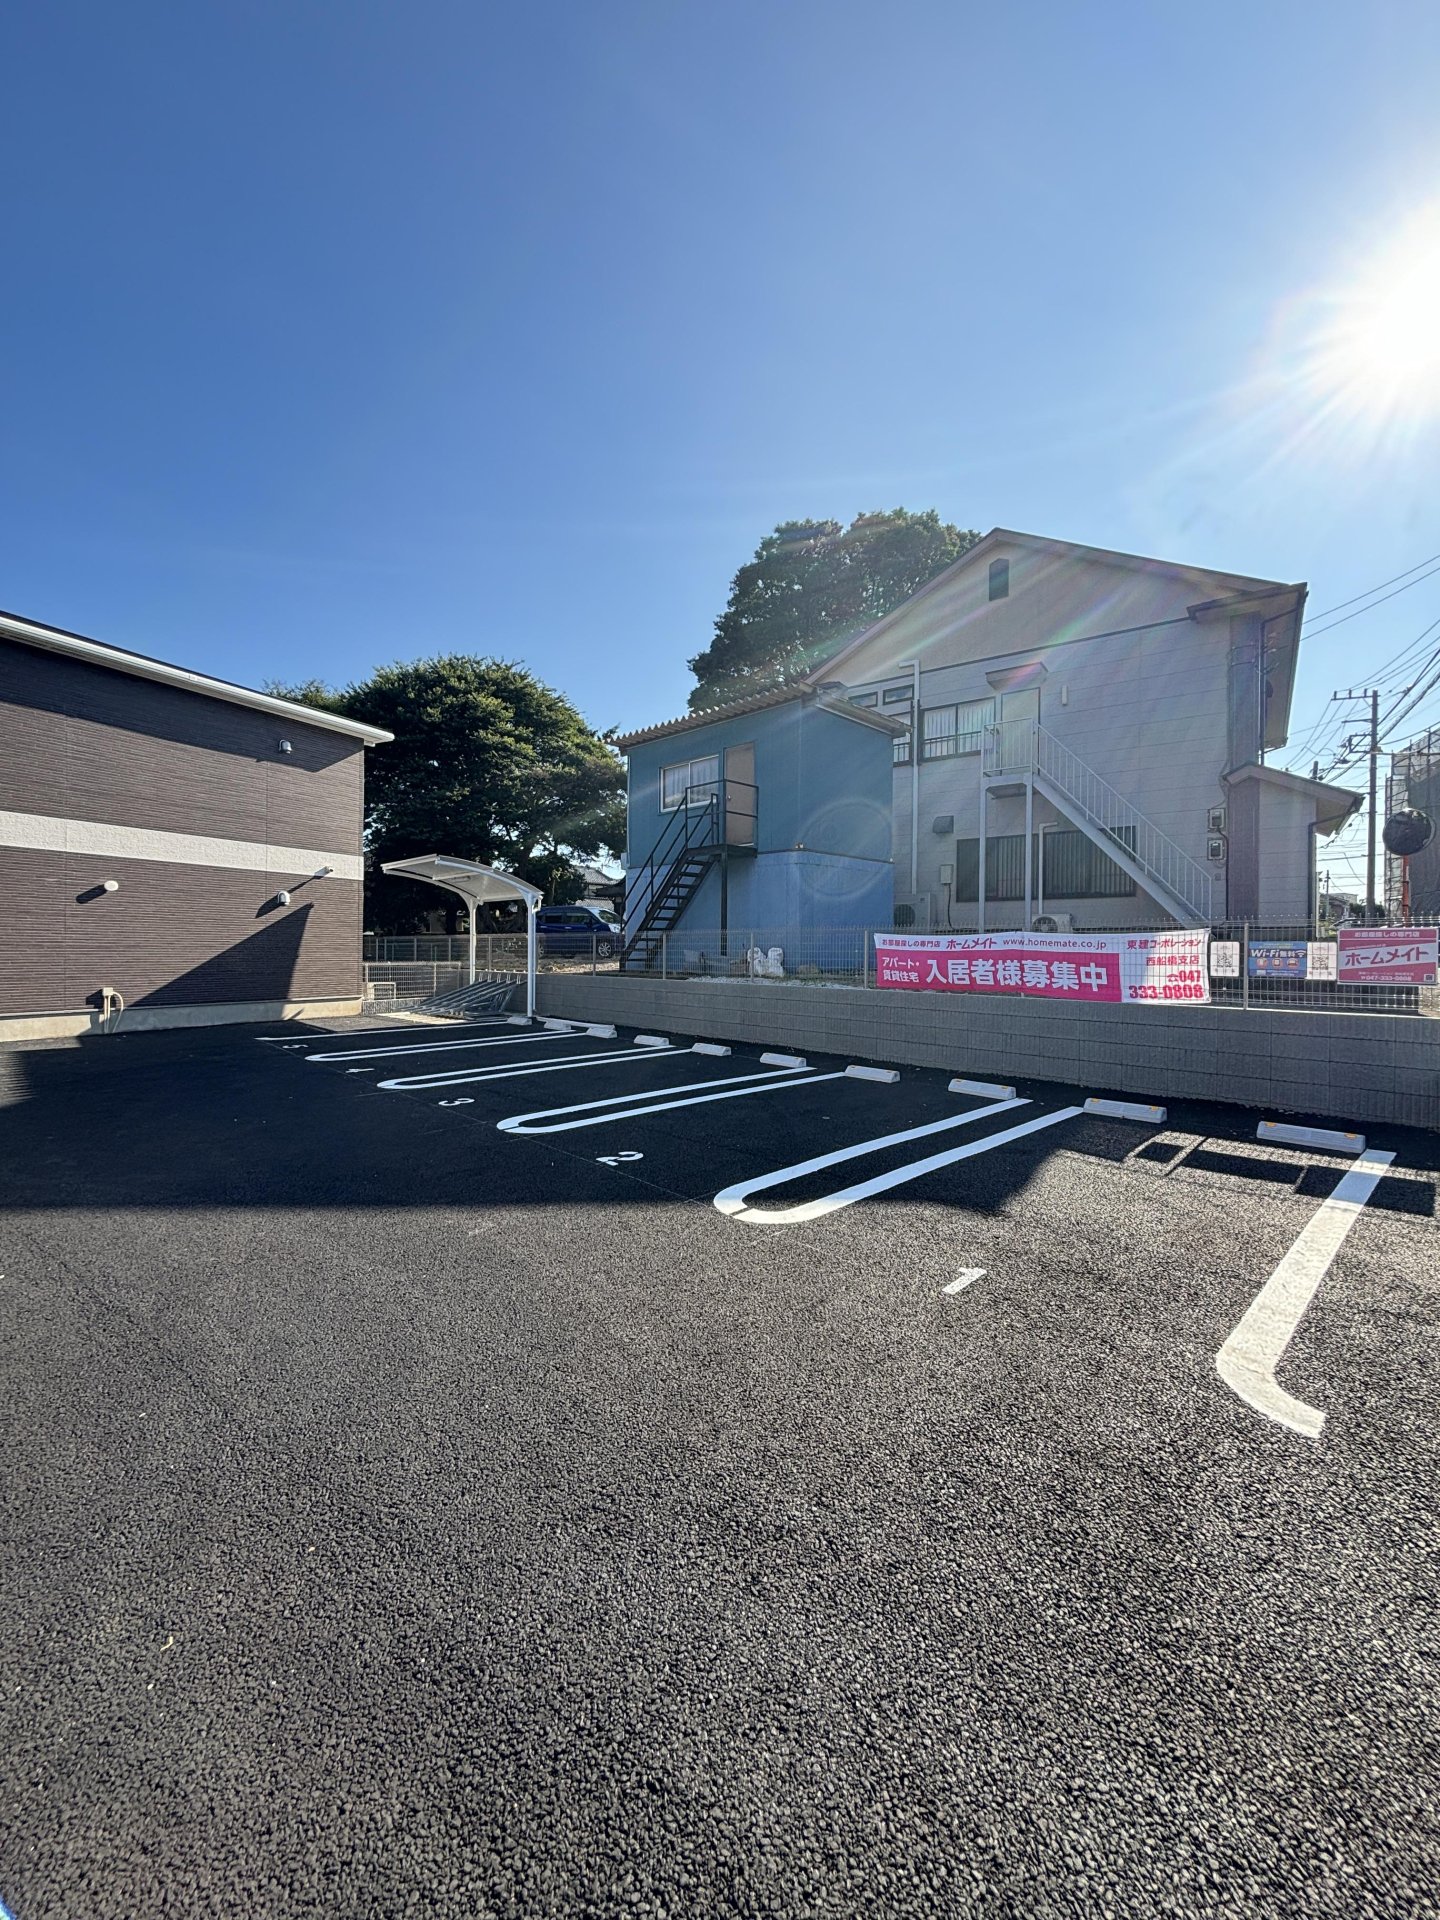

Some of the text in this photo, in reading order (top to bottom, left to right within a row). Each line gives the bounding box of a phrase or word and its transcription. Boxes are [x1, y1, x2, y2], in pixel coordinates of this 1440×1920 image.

[882, 937, 1107, 950] お部屋探しの専門店 ホームメイト www.homemate.co.jp
[1127, 938, 1202, 950] 東建コーポレーション
[1146, 954, 1200, 966] 西船橋支店
[1345, 946, 1429, 966] ホームメイト
[882, 969, 919, 982] 賃貸住宅
[926, 958, 1108, 992] 入居者様募集中
[1128, 983, 1204, 999] 333-0808
[438, 1097, 475, 1107] 3
[596, 1151, 644, 1166] 2
[942, 1267, 987, 1295] 1
